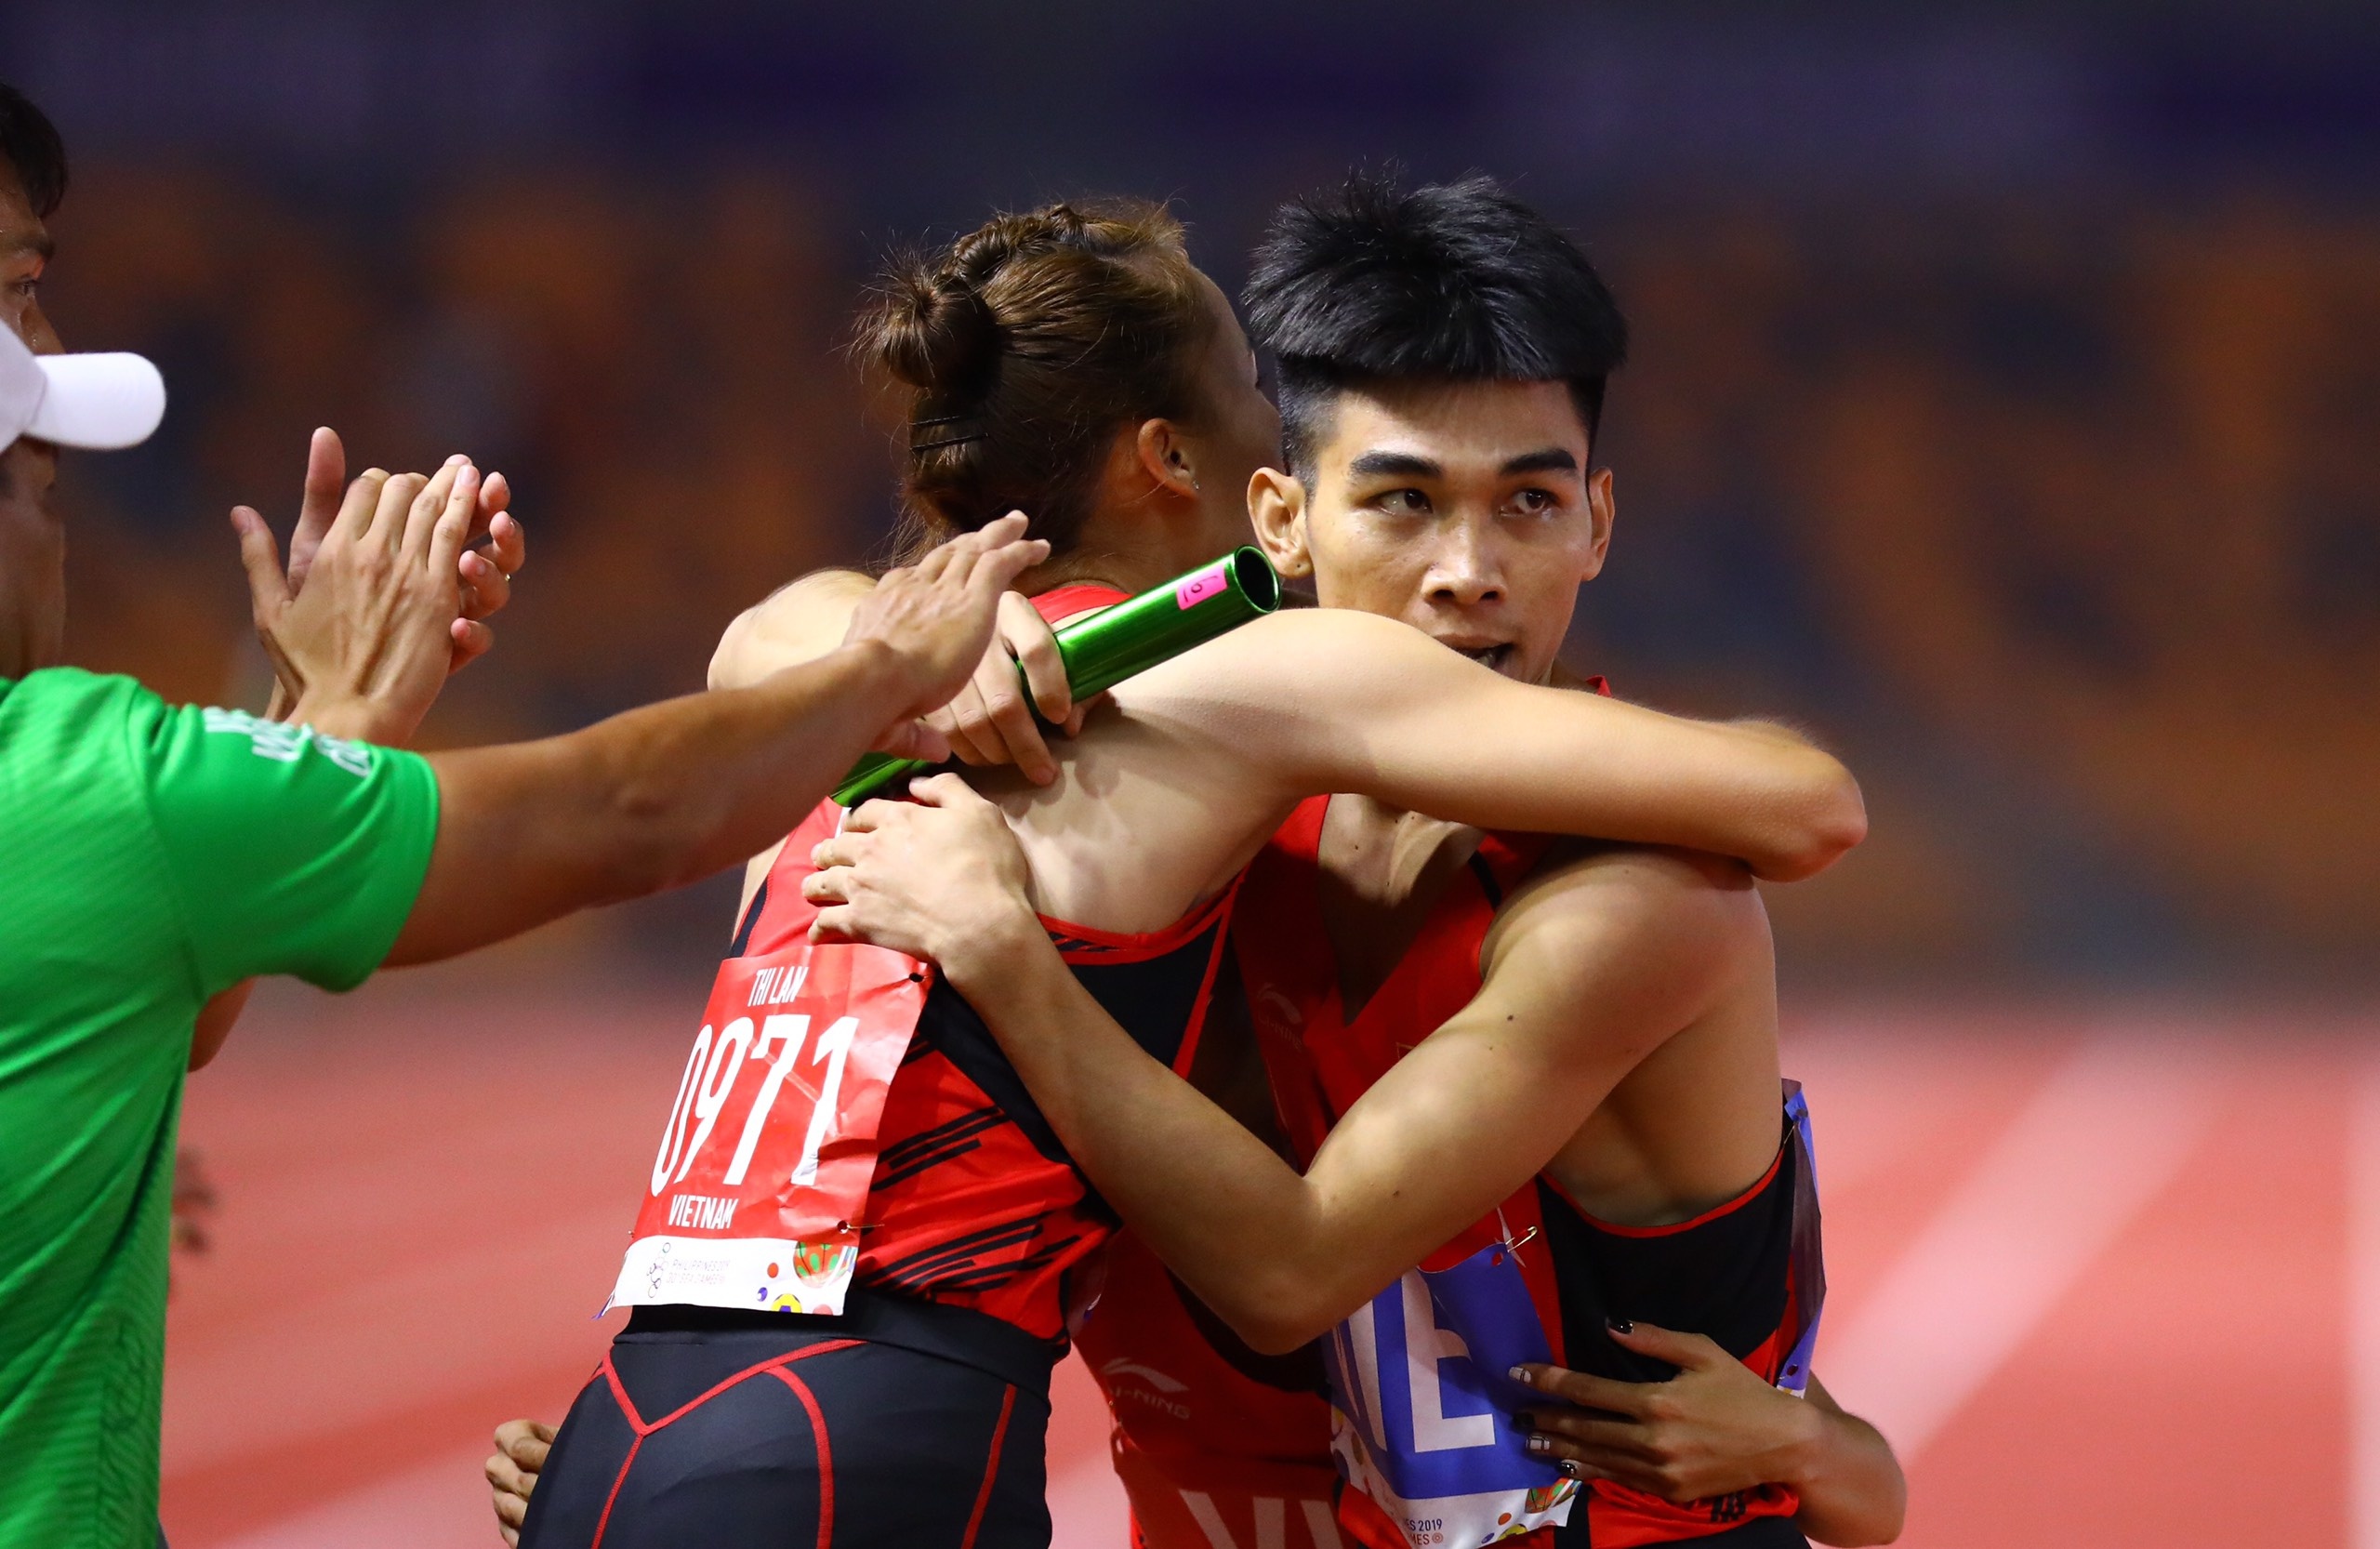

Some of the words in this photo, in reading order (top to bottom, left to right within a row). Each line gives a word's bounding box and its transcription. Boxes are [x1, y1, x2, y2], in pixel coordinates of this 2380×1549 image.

[768, 965, 809, 1004] LAN
[651, 1014, 859, 1197] 0971
[668, 1195, 738, 1229] VIETNAM
[1110, 1385, 1191, 1421] I-NING
[1418, 1518, 1442, 1531] 2019
